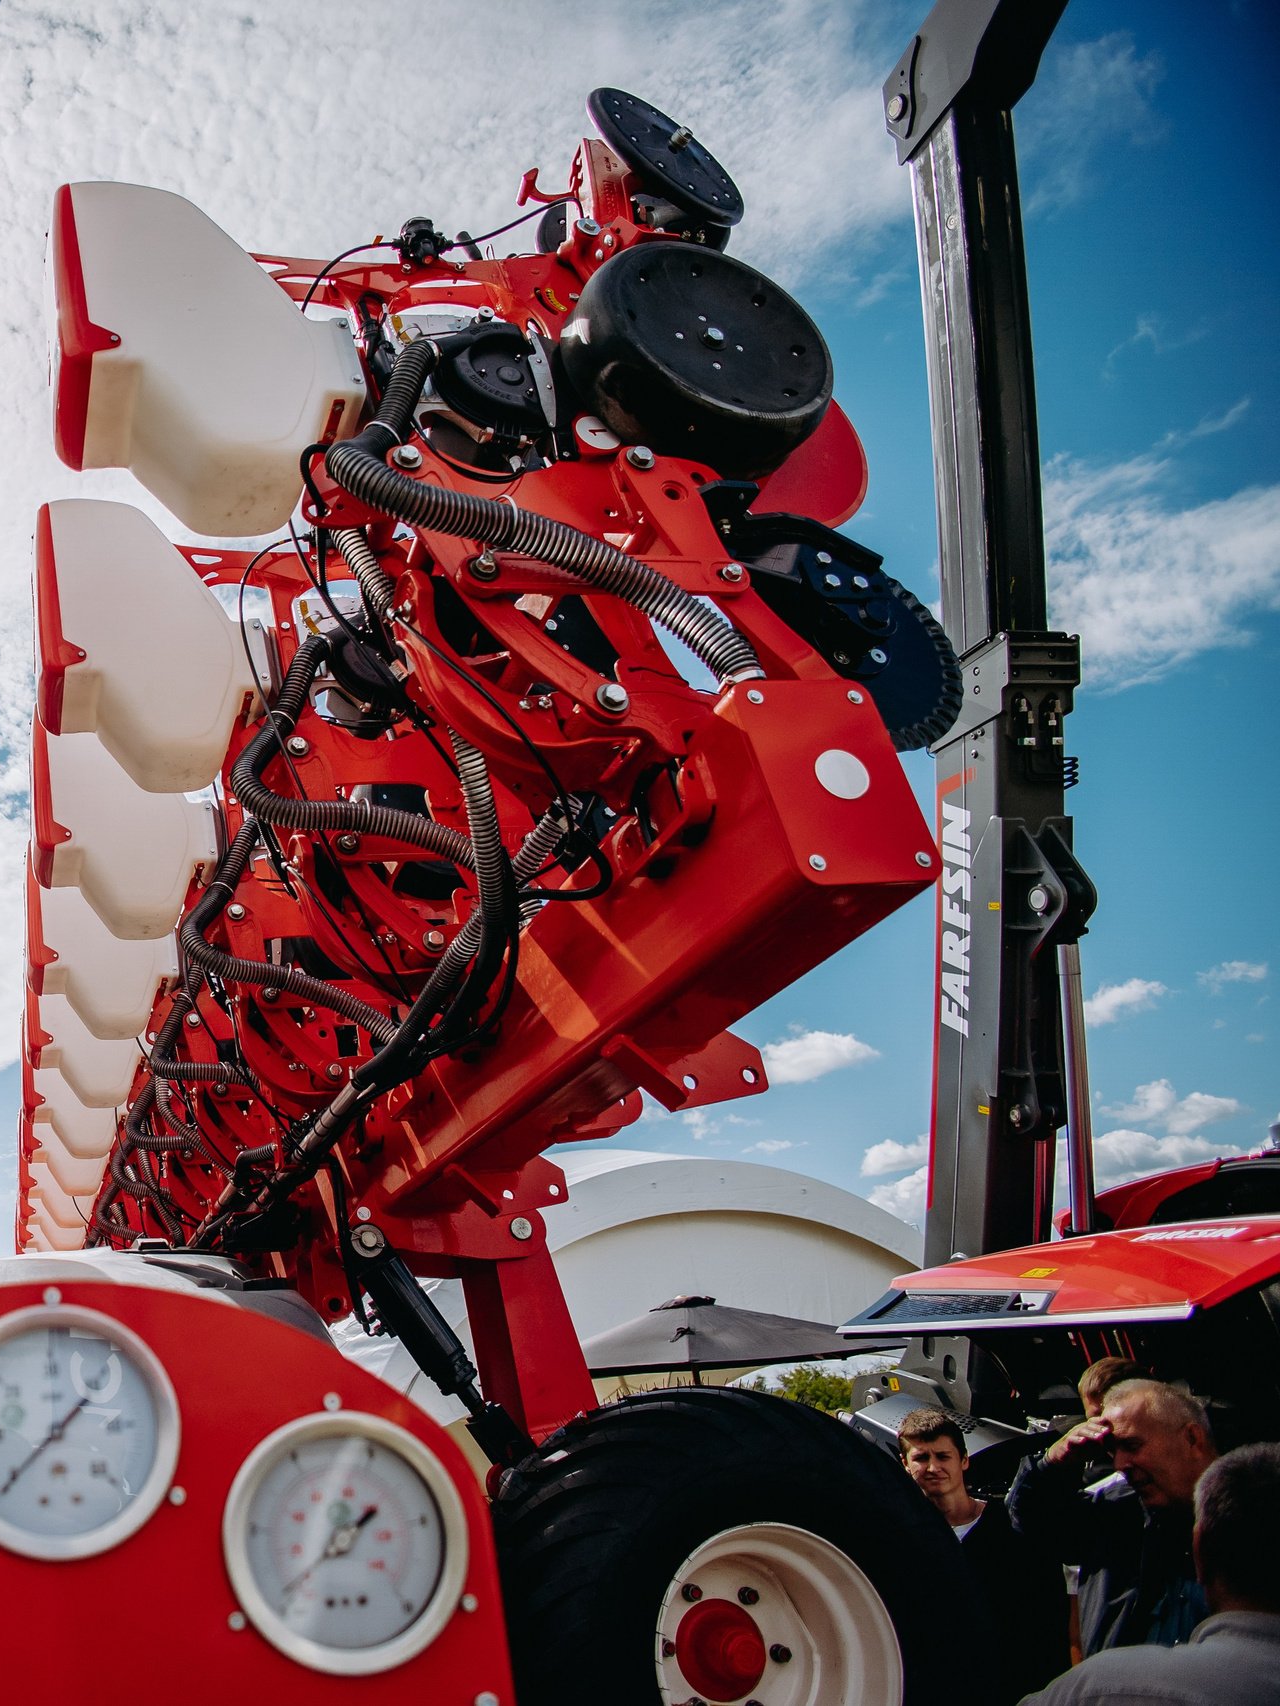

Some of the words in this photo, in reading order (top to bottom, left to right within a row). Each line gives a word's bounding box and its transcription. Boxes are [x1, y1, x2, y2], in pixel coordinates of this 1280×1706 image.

[588, 428, 607, 437] 1
[941, 801, 972, 1039] FARESIN
[1128, 1226, 1251, 1243] FARESIN
